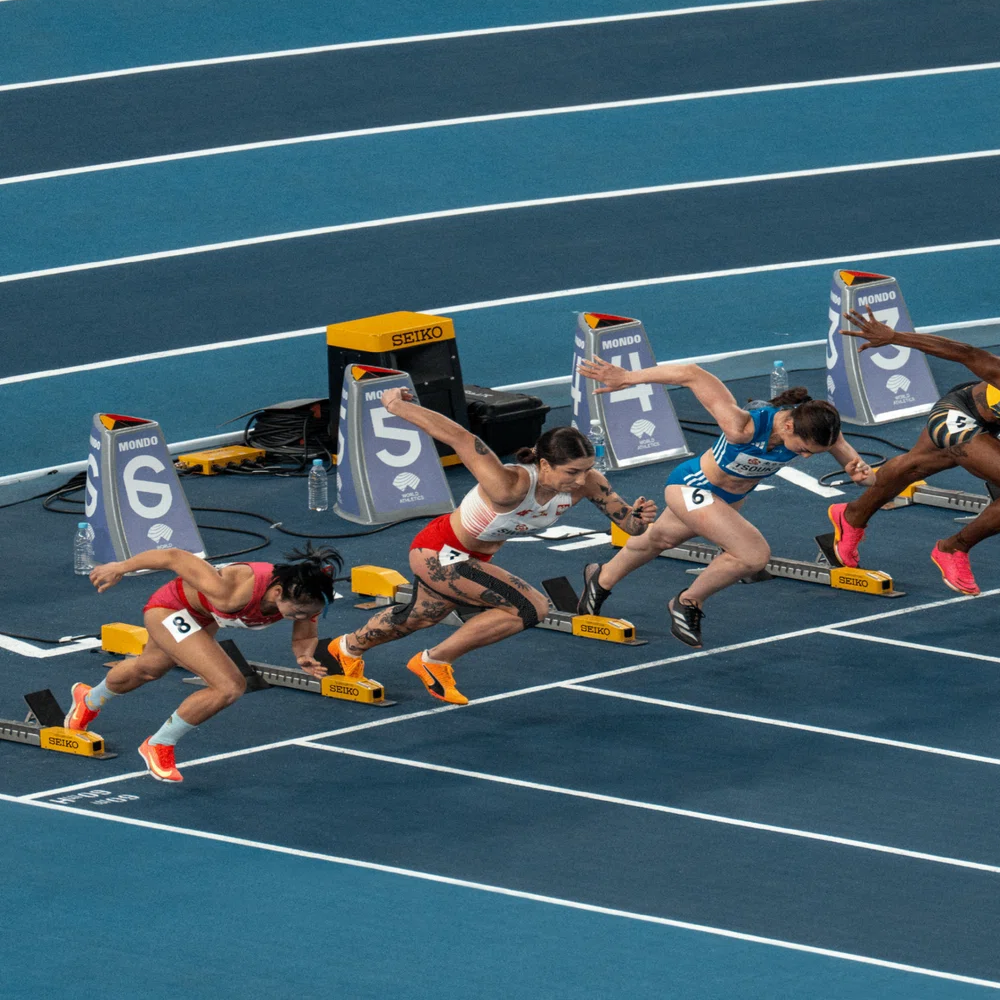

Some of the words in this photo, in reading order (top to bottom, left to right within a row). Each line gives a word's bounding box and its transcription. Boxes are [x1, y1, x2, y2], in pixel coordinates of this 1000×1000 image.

[858, 290, 897, 307] MONDO
[391, 325, 443, 347] SEIKO
[602, 334, 642, 351] MONDO
[862, 306, 911, 371] 3
[610, 351, 654, 412] 4
[955, 415, 967, 428] 5
[118, 435, 159, 453] MONDO
[370, 406, 422, 468] 5
[123, 454, 173, 519] 6
[691, 488, 705, 505] 6
[838, 576, 869, 588] SEIKO
[172, 616, 191, 634] 8
[580, 624, 611, 636] SEIKO
[329, 685, 360, 697] SEIKO
[48, 736, 79, 749] SEIKO
